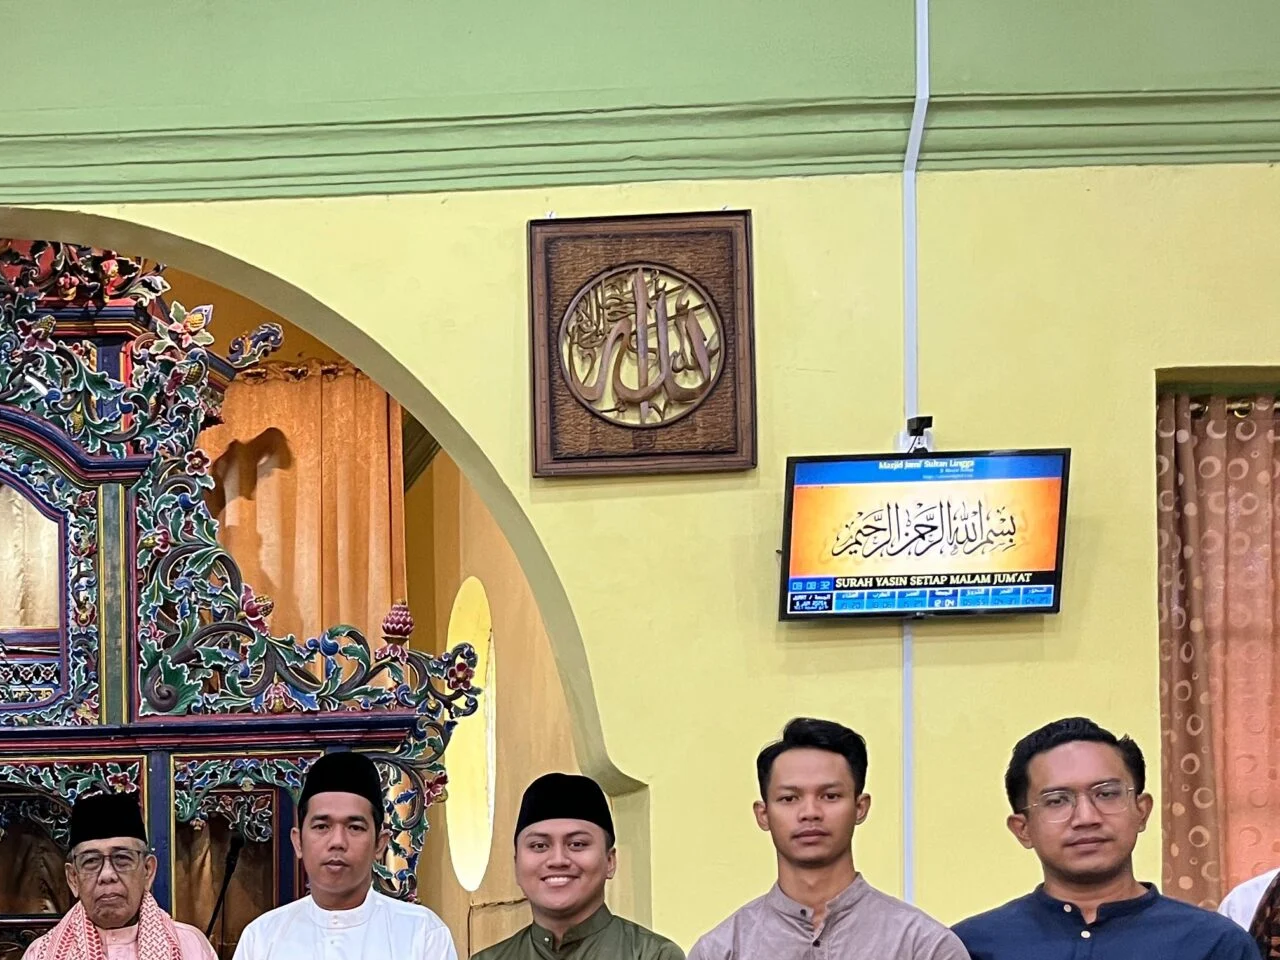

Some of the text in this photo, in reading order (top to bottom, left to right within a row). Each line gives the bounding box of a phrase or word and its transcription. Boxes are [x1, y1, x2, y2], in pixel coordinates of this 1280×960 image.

[924, 460, 948, 468] Sultan
[949, 459, 975, 469] Lingga
[835, 578, 873, 588] SURAH
[876, 576, 908, 587] YASIN
[910, 575, 948, 586] SETIAP
[949, 574, 991, 585] MALAM
